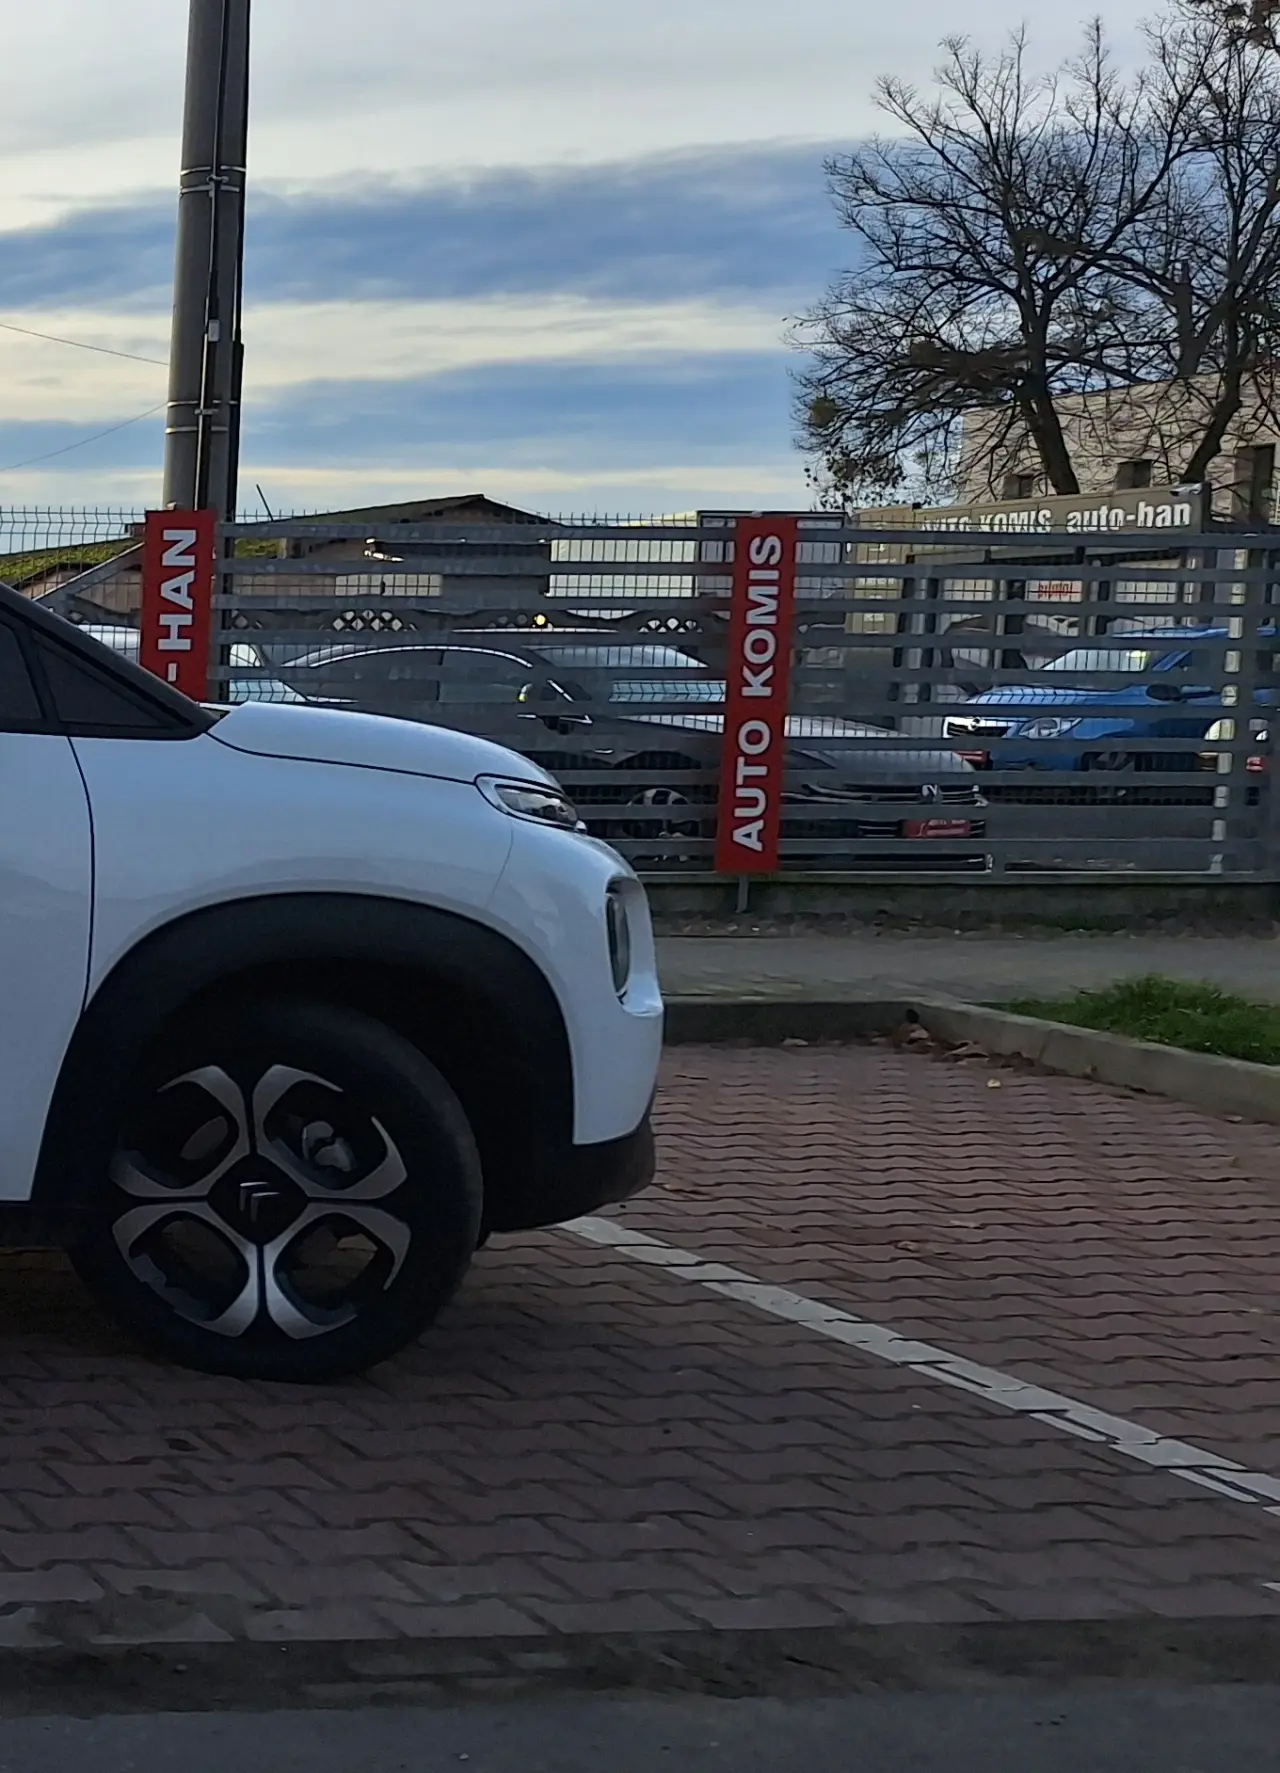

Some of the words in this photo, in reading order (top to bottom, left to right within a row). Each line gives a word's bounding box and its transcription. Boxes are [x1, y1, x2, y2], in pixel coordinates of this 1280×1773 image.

[978, 508, 1052, 534] KOMIS
[1066, 501, 1191, 534] auto-han
[741, 534, 782, 698] KOMIS
[732, 719, 771, 852] AUTO
